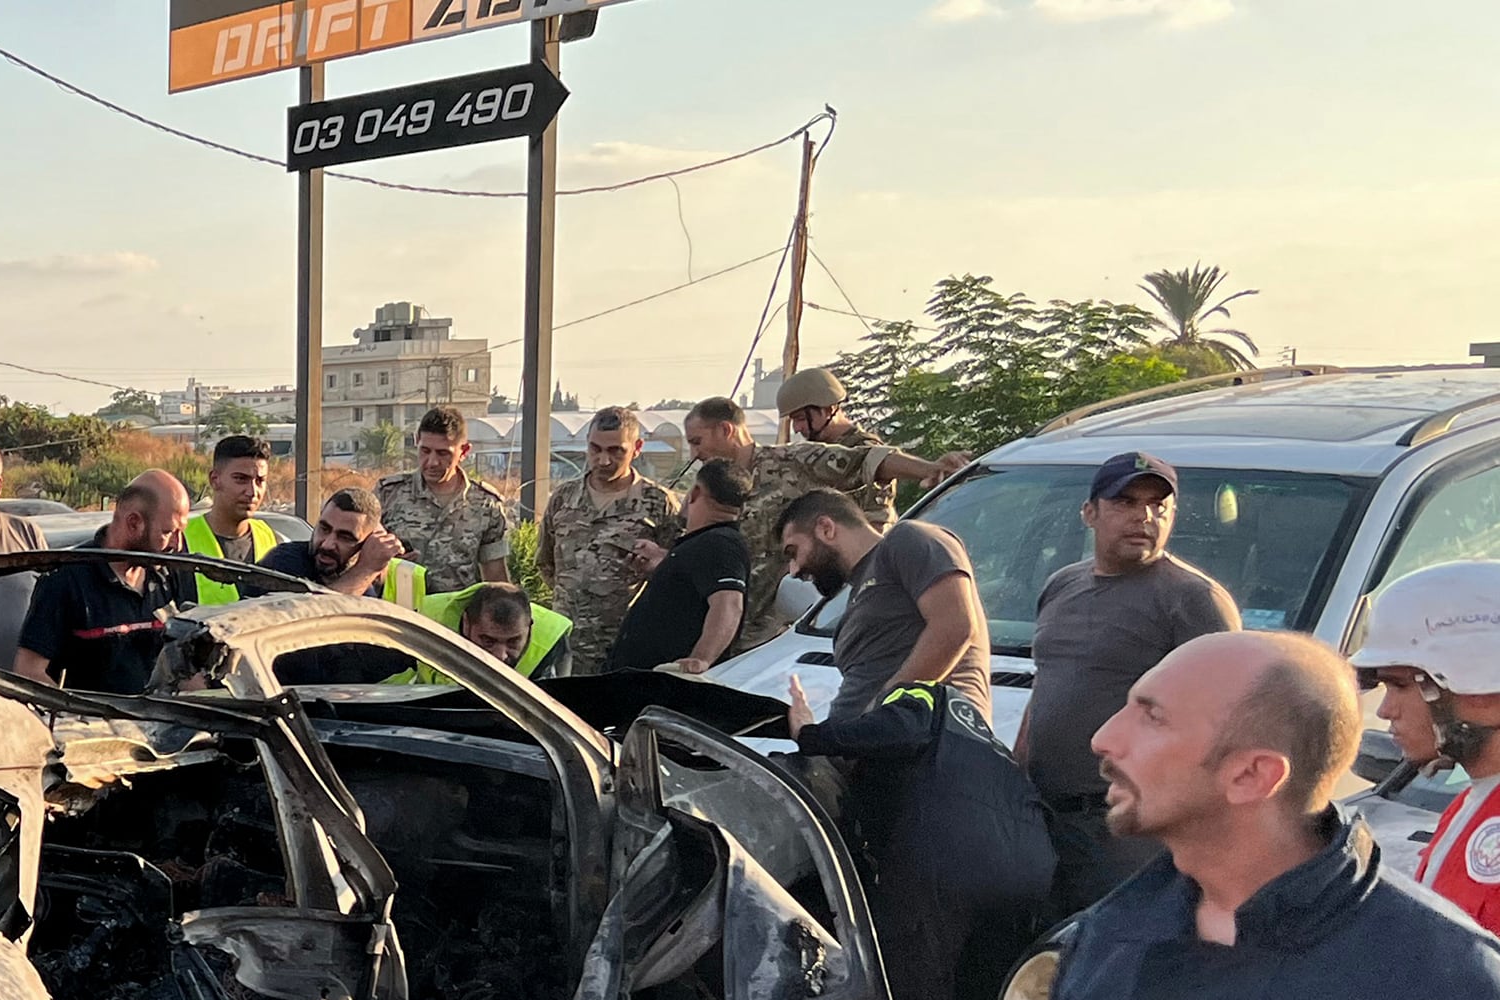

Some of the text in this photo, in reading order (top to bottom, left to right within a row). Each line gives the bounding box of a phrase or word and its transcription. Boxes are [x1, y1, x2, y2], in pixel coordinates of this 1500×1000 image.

[293, 82, 535, 154] 03 049 490
